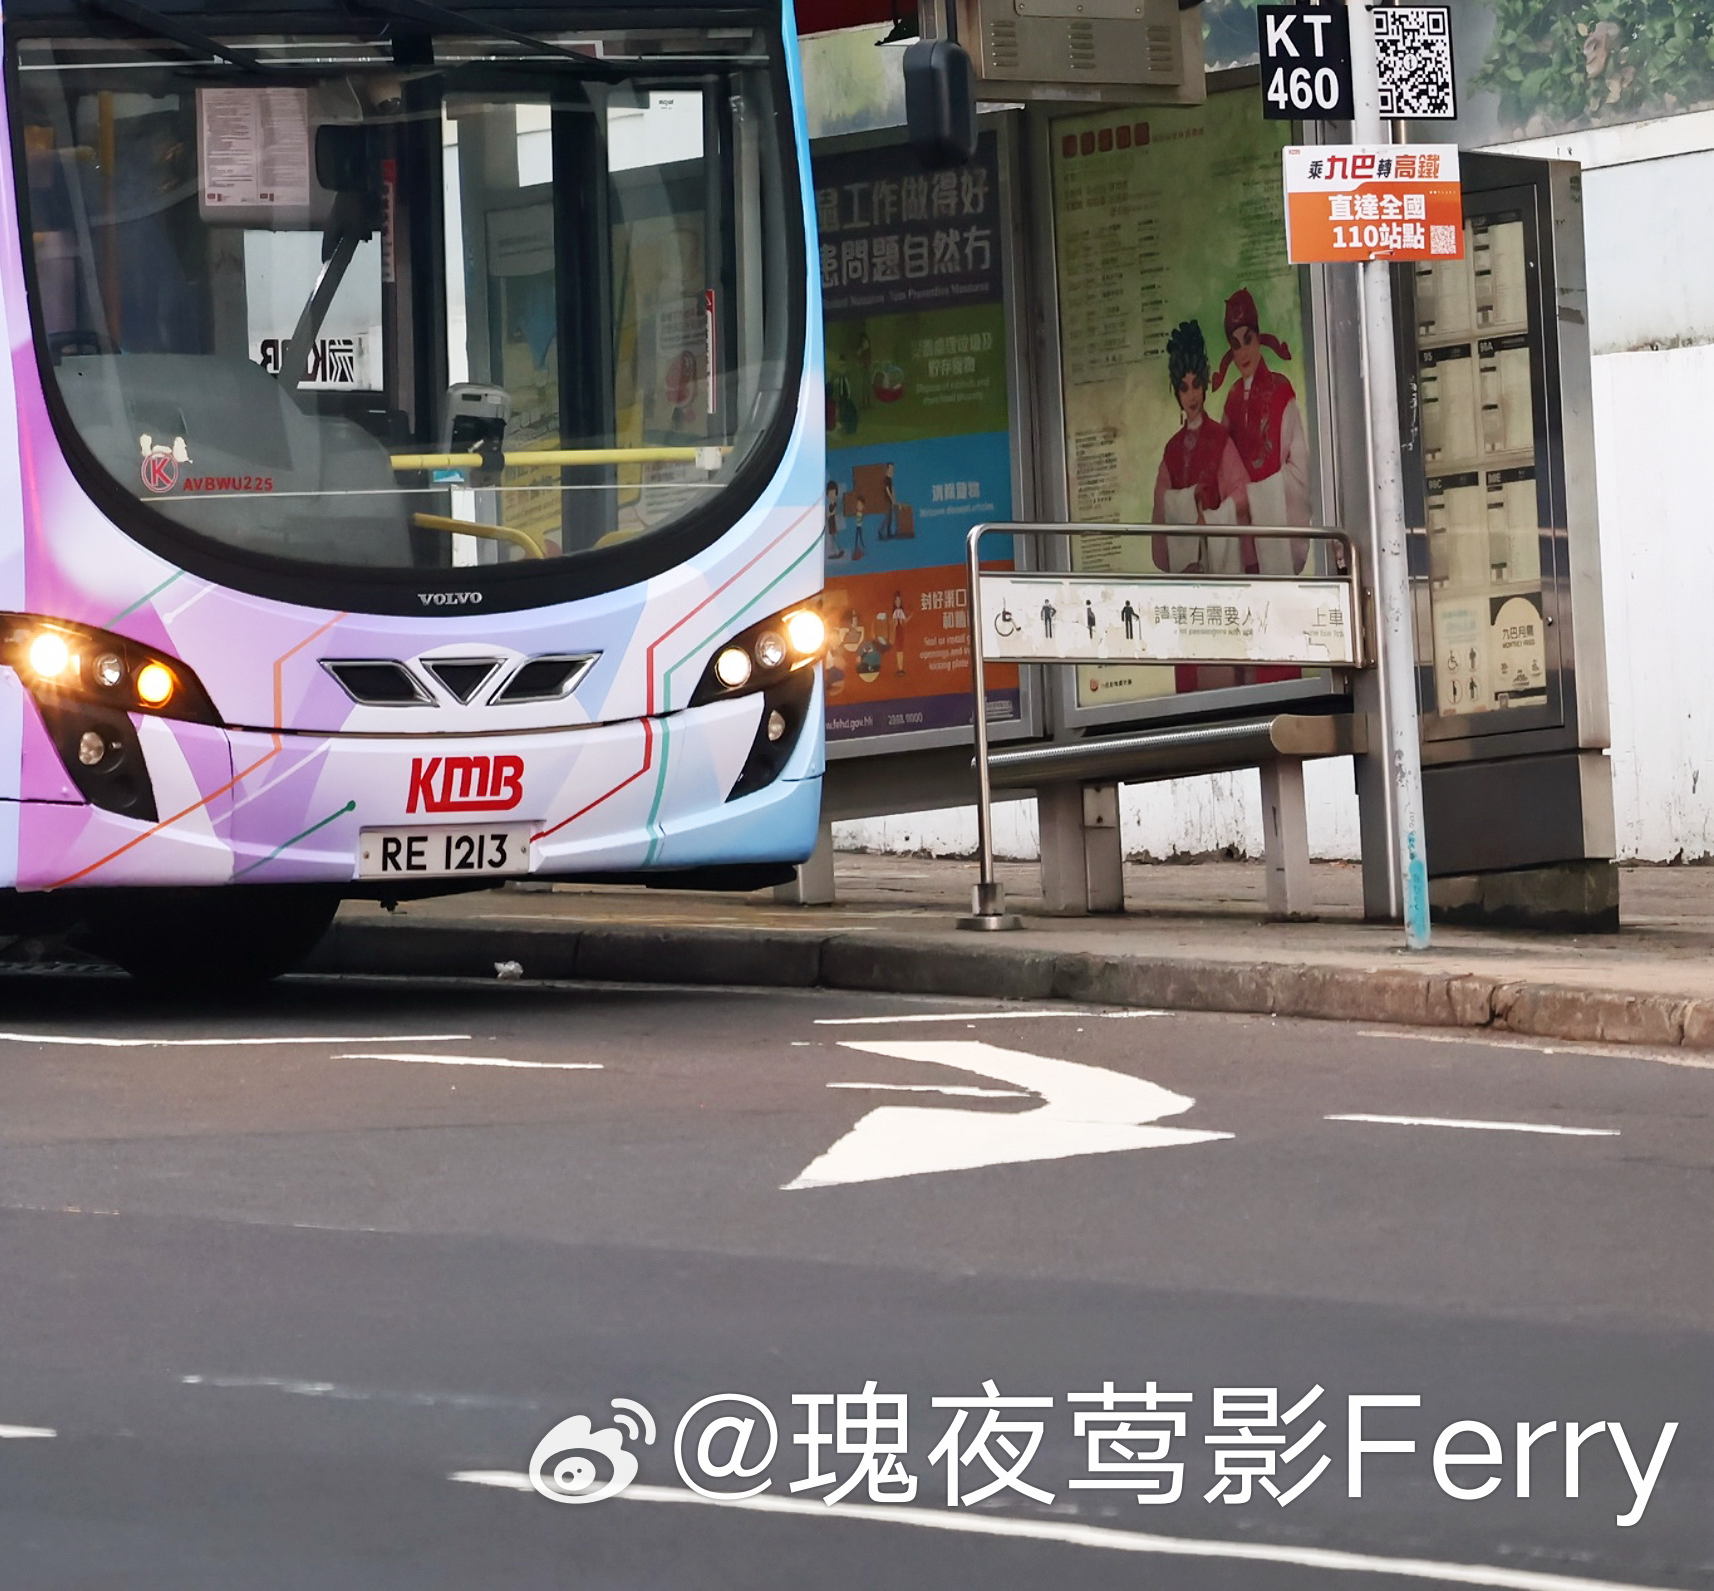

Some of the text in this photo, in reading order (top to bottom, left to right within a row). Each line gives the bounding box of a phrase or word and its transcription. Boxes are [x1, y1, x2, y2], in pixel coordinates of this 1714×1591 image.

[1265, 14, 1332, 58] KT
[1266, 66, 1340, 110] 460
[1307, 153, 1441, 181] 乘九巴轉高鐵
[1328, 193, 1427, 221] 直達全國
[1332, 222, 1425, 250] 110站點
[182, 475, 274, 492] AVBWU225
[416, 591, 482, 606] VOLVO
[1312, 607, 1344, 628] 上車
[405, 754, 524, 814] KMB
[381, 833, 509, 872] RE 1213
